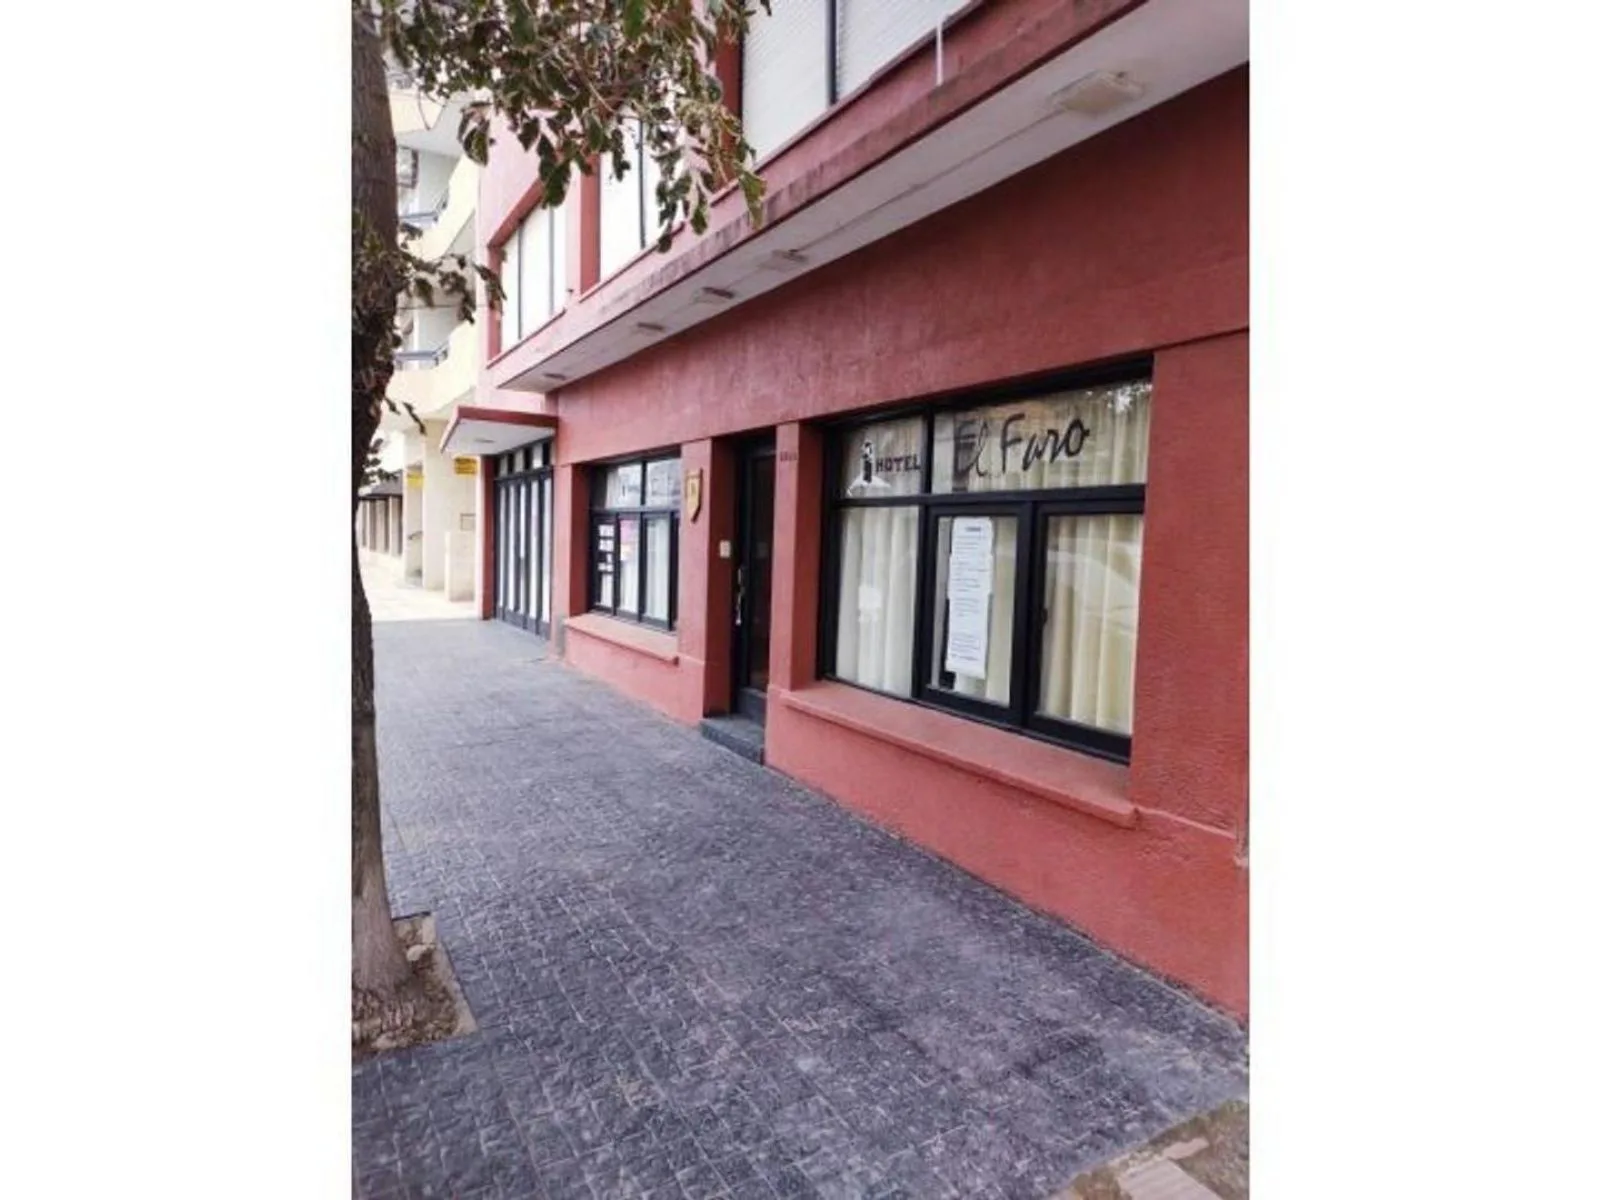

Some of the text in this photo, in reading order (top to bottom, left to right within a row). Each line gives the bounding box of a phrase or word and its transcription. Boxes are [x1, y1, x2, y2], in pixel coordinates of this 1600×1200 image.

[875, 453, 921, 473] HOTEL
[954, 413, 1090, 477] El Faro
